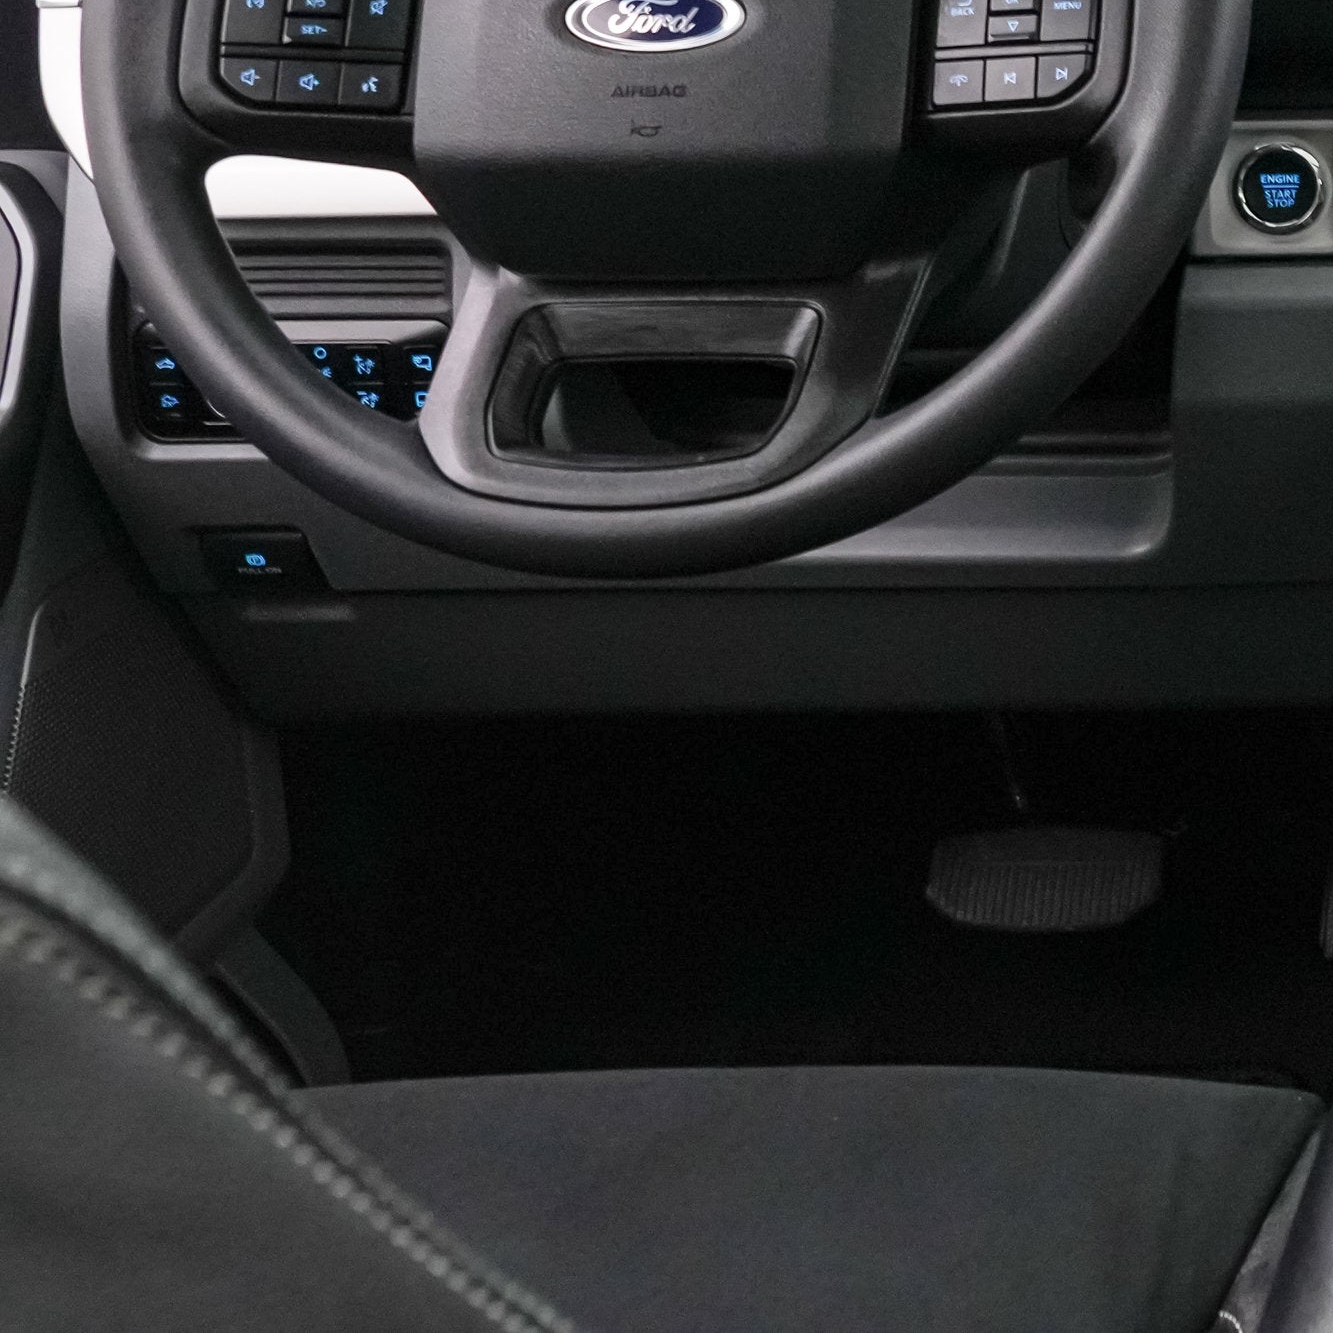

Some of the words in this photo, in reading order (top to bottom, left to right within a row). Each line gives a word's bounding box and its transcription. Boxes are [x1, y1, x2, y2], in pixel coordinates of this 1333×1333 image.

[1054, 1, 1082, 10] MENU
[950, 7, 976, 16] BACK
[610, 85, 688, 98] AIRBAG
[1260, 173, 1300, 184] ENGINE
[1264, 189, 1297, 199] START
[1267, 199, 1295, 208] STOP
